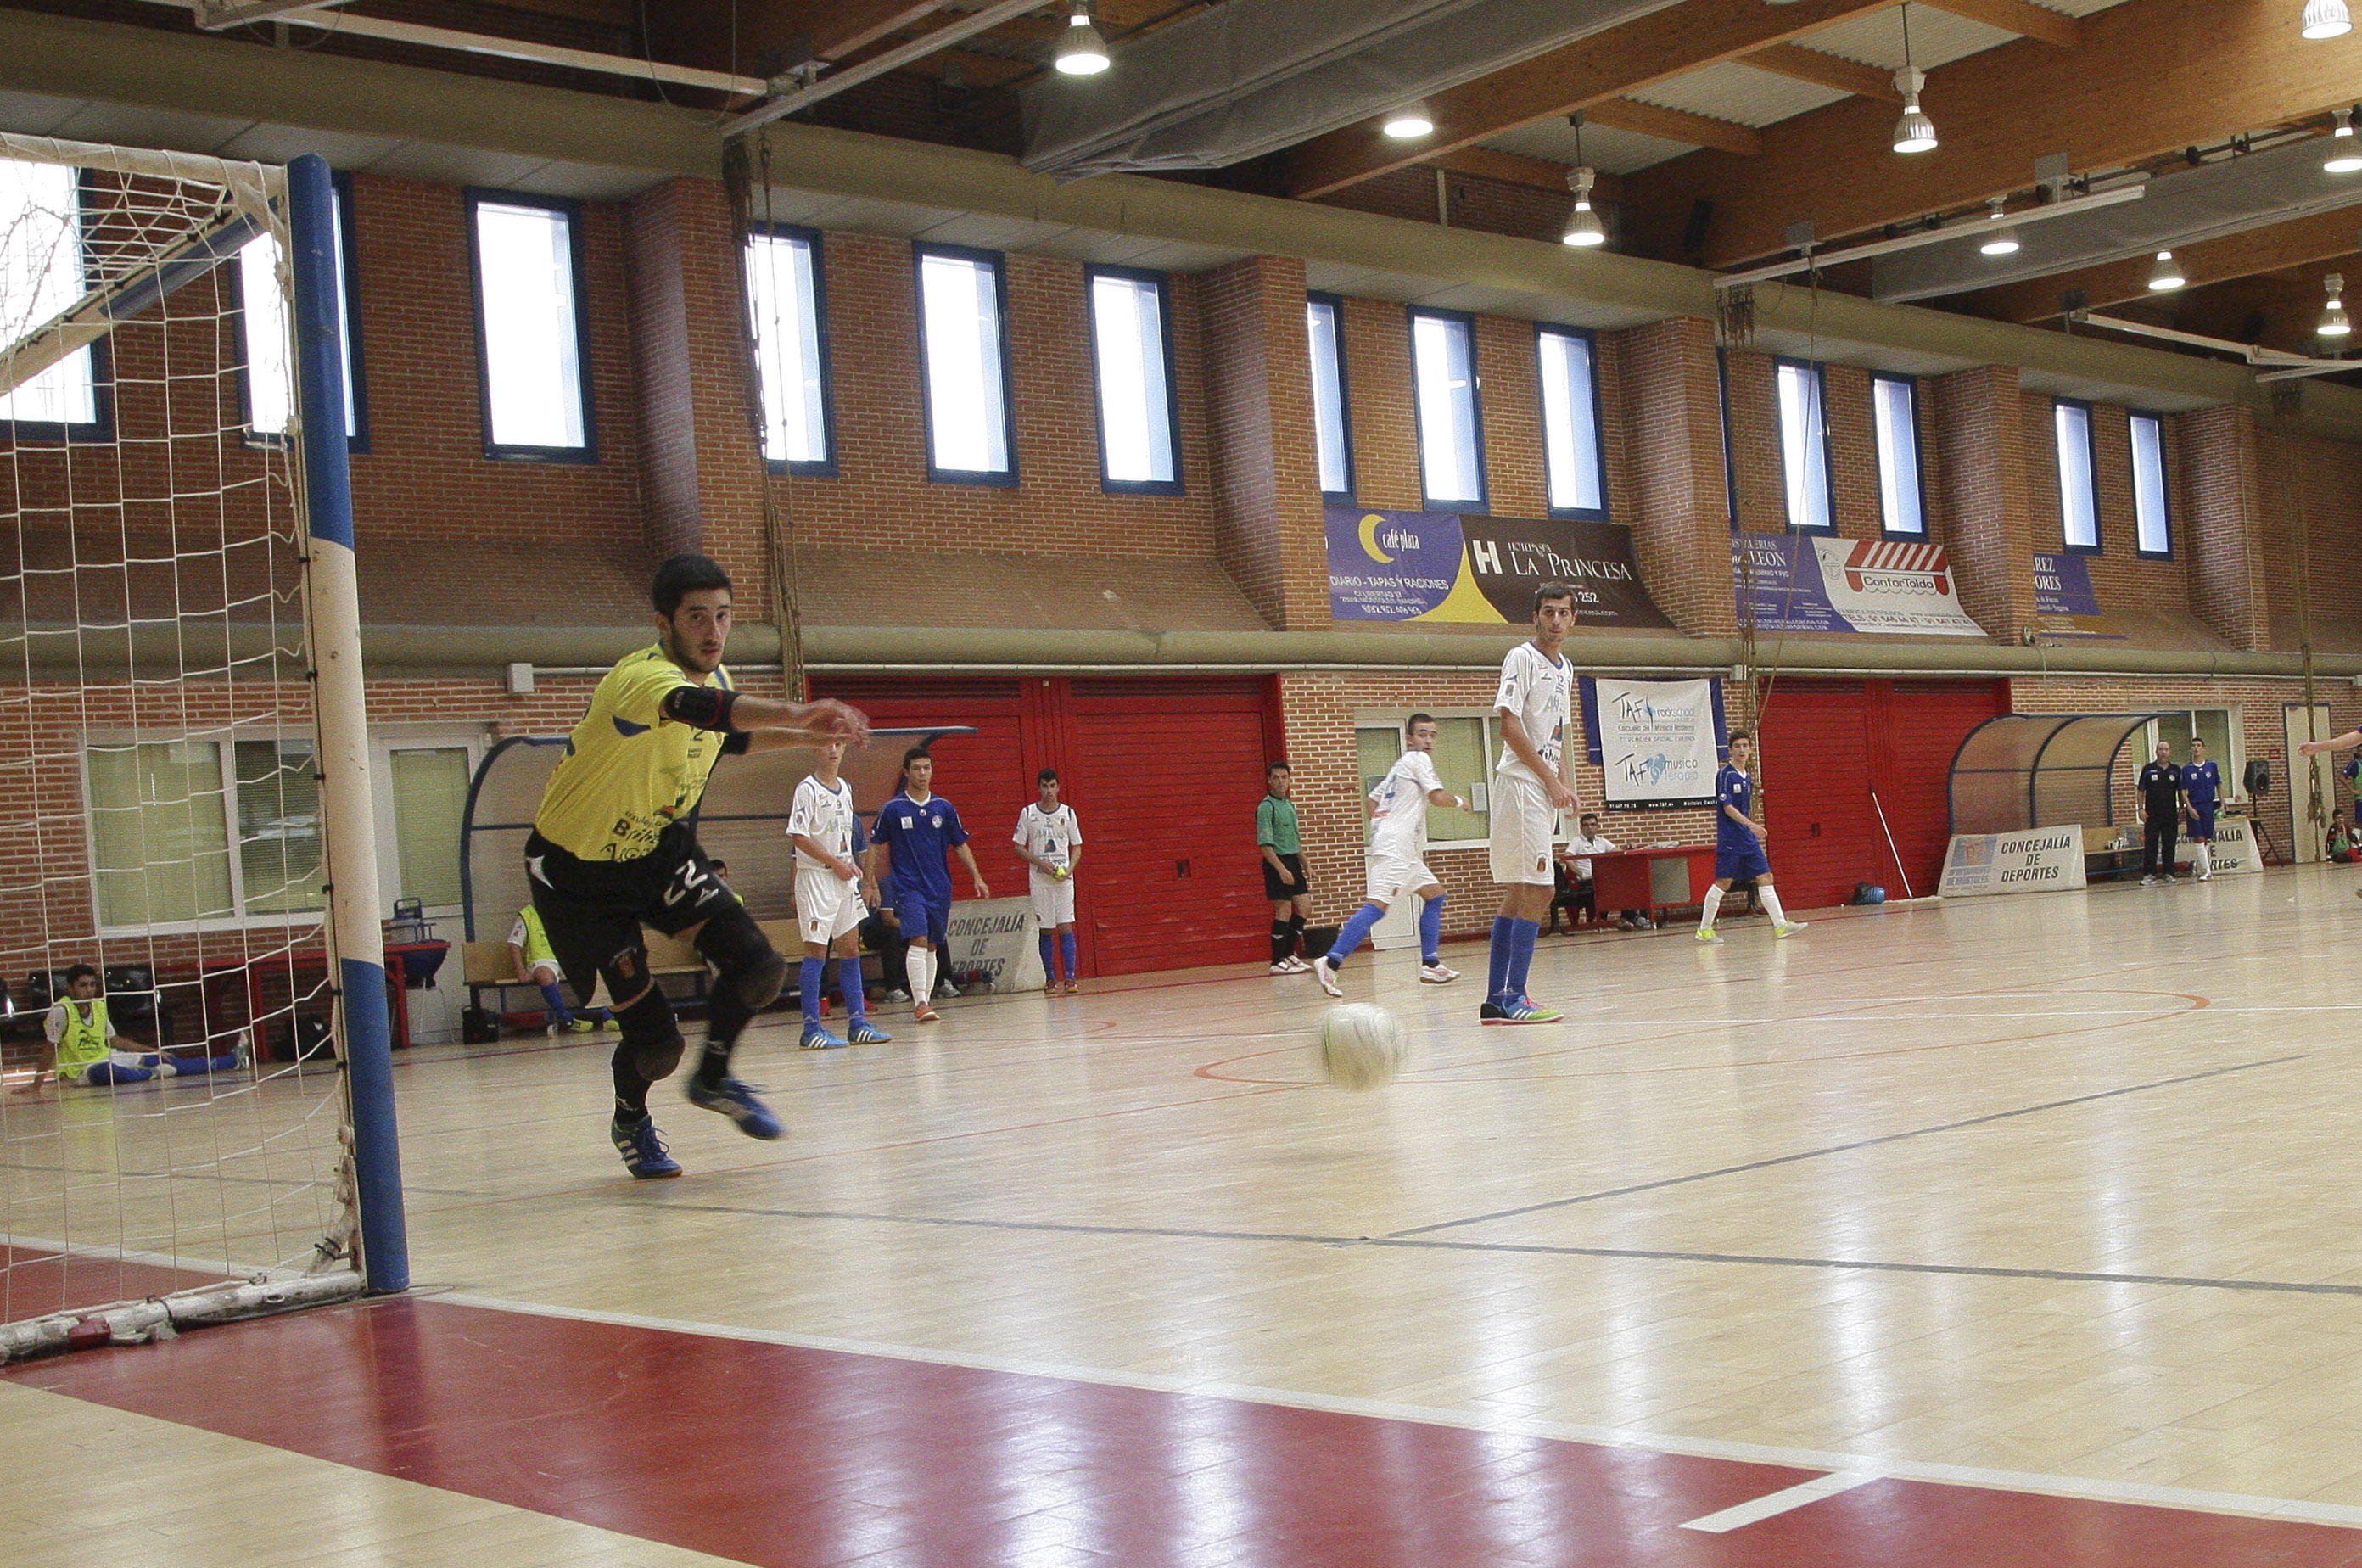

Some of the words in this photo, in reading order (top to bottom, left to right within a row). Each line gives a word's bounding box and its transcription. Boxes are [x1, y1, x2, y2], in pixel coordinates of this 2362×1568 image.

[1382, 529, 1399, 550] café
[1400, 529, 1421, 552] plaza
[1511, 552, 1540, 576] LA
[1548, 552, 1632, 580] PRINCESA
[1329, 575, 1363, 587] DIARIO
[1367, 576, 1396, 588] TAPAS
[1396, 577, 1403, 587] Y
[1404, 578, 1449, 591] RACIONES
[1612, 692, 1644, 723] TAF
[1615, 753, 1649, 787] TAF
[2001, 834, 2071, 854] CONCEJALÍA
[2025, 854, 2041, 867] DE
[2001, 866, 2059, 883] DEPORTES
[970, 938, 989, 957] DE
[952, 957, 1005, 977] EPORTES
